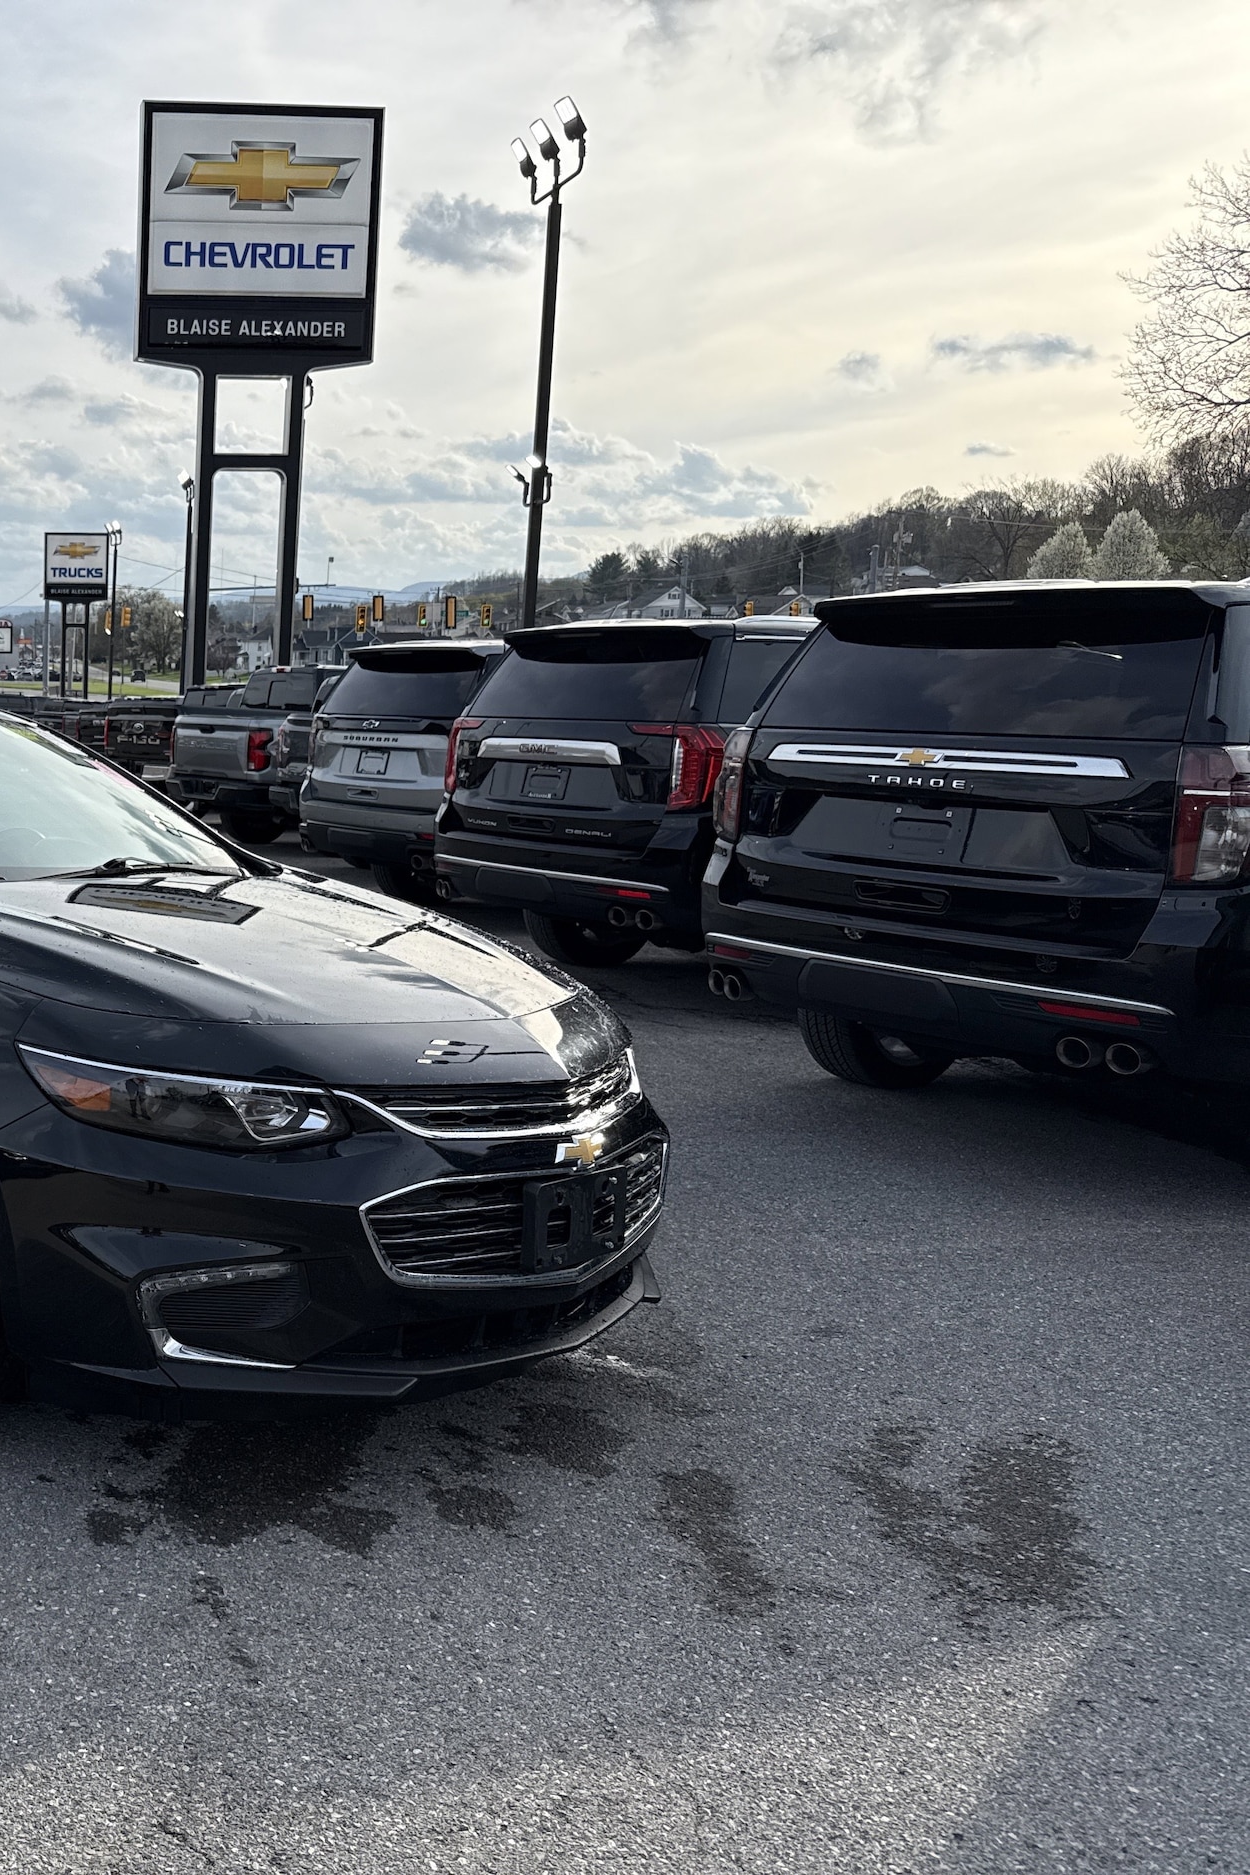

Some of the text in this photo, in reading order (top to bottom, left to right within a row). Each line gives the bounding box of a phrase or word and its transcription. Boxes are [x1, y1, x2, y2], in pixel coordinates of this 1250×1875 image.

[163, 241, 355, 270] CHEVROLET
[167, 319, 346, 338] BLAISE ALEXANDER
[50, 567, 103, 578] TRUCKS
[343, 735, 399, 743] SUBURBAN
[518, 743, 558, 755] GMC
[868, 774, 966, 790] TAHOE
[467, 817, 497, 827] YUKON
[565, 828, 612, 838] DENALI
